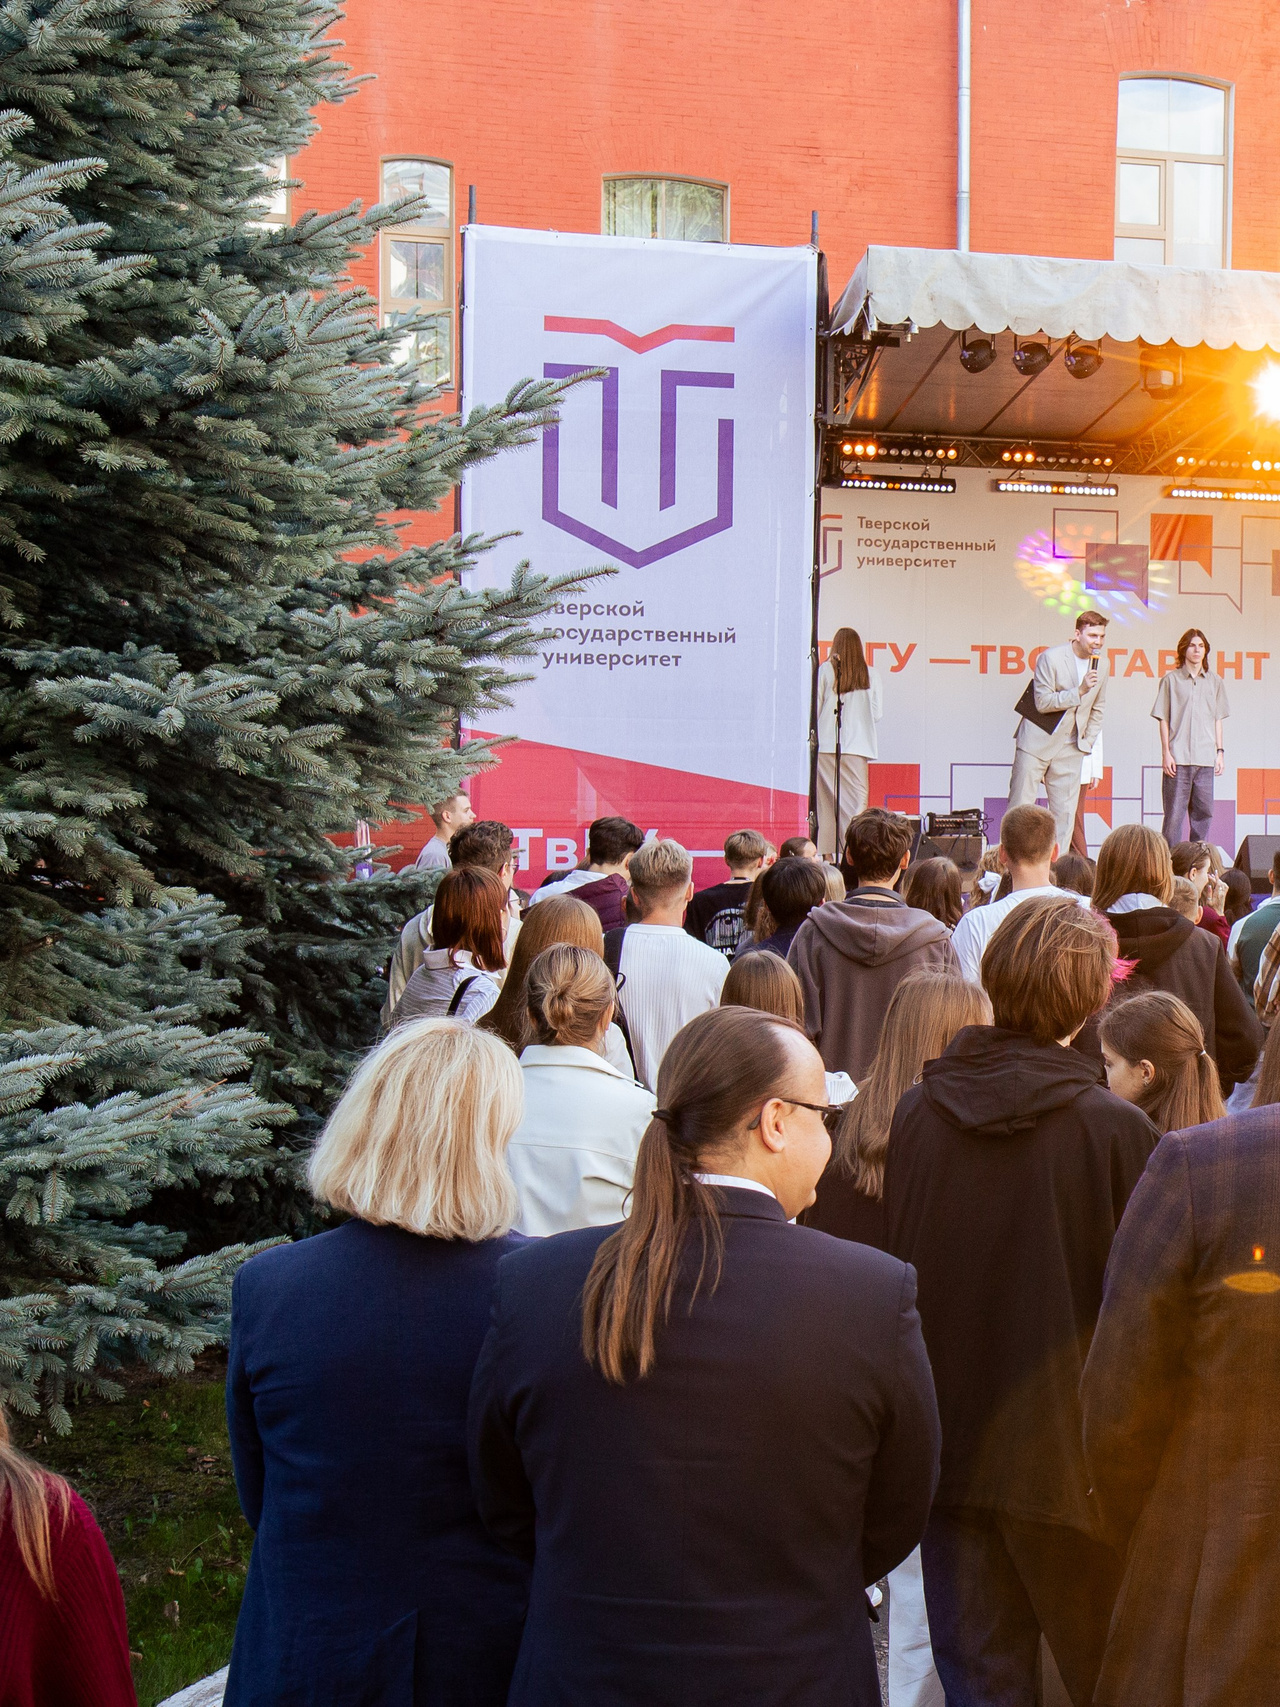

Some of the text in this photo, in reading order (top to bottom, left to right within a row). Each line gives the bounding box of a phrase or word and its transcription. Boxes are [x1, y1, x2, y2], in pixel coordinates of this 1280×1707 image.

[857, 515, 930, 533] Тверской
[857, 537, 996, 552] государственный
[857, 554, 957, 571] университет
[554, 599, 645, 621] верской
[542, 651, 682, 671] университет
[1107, 647, 1270, 681] ГАРНТ
